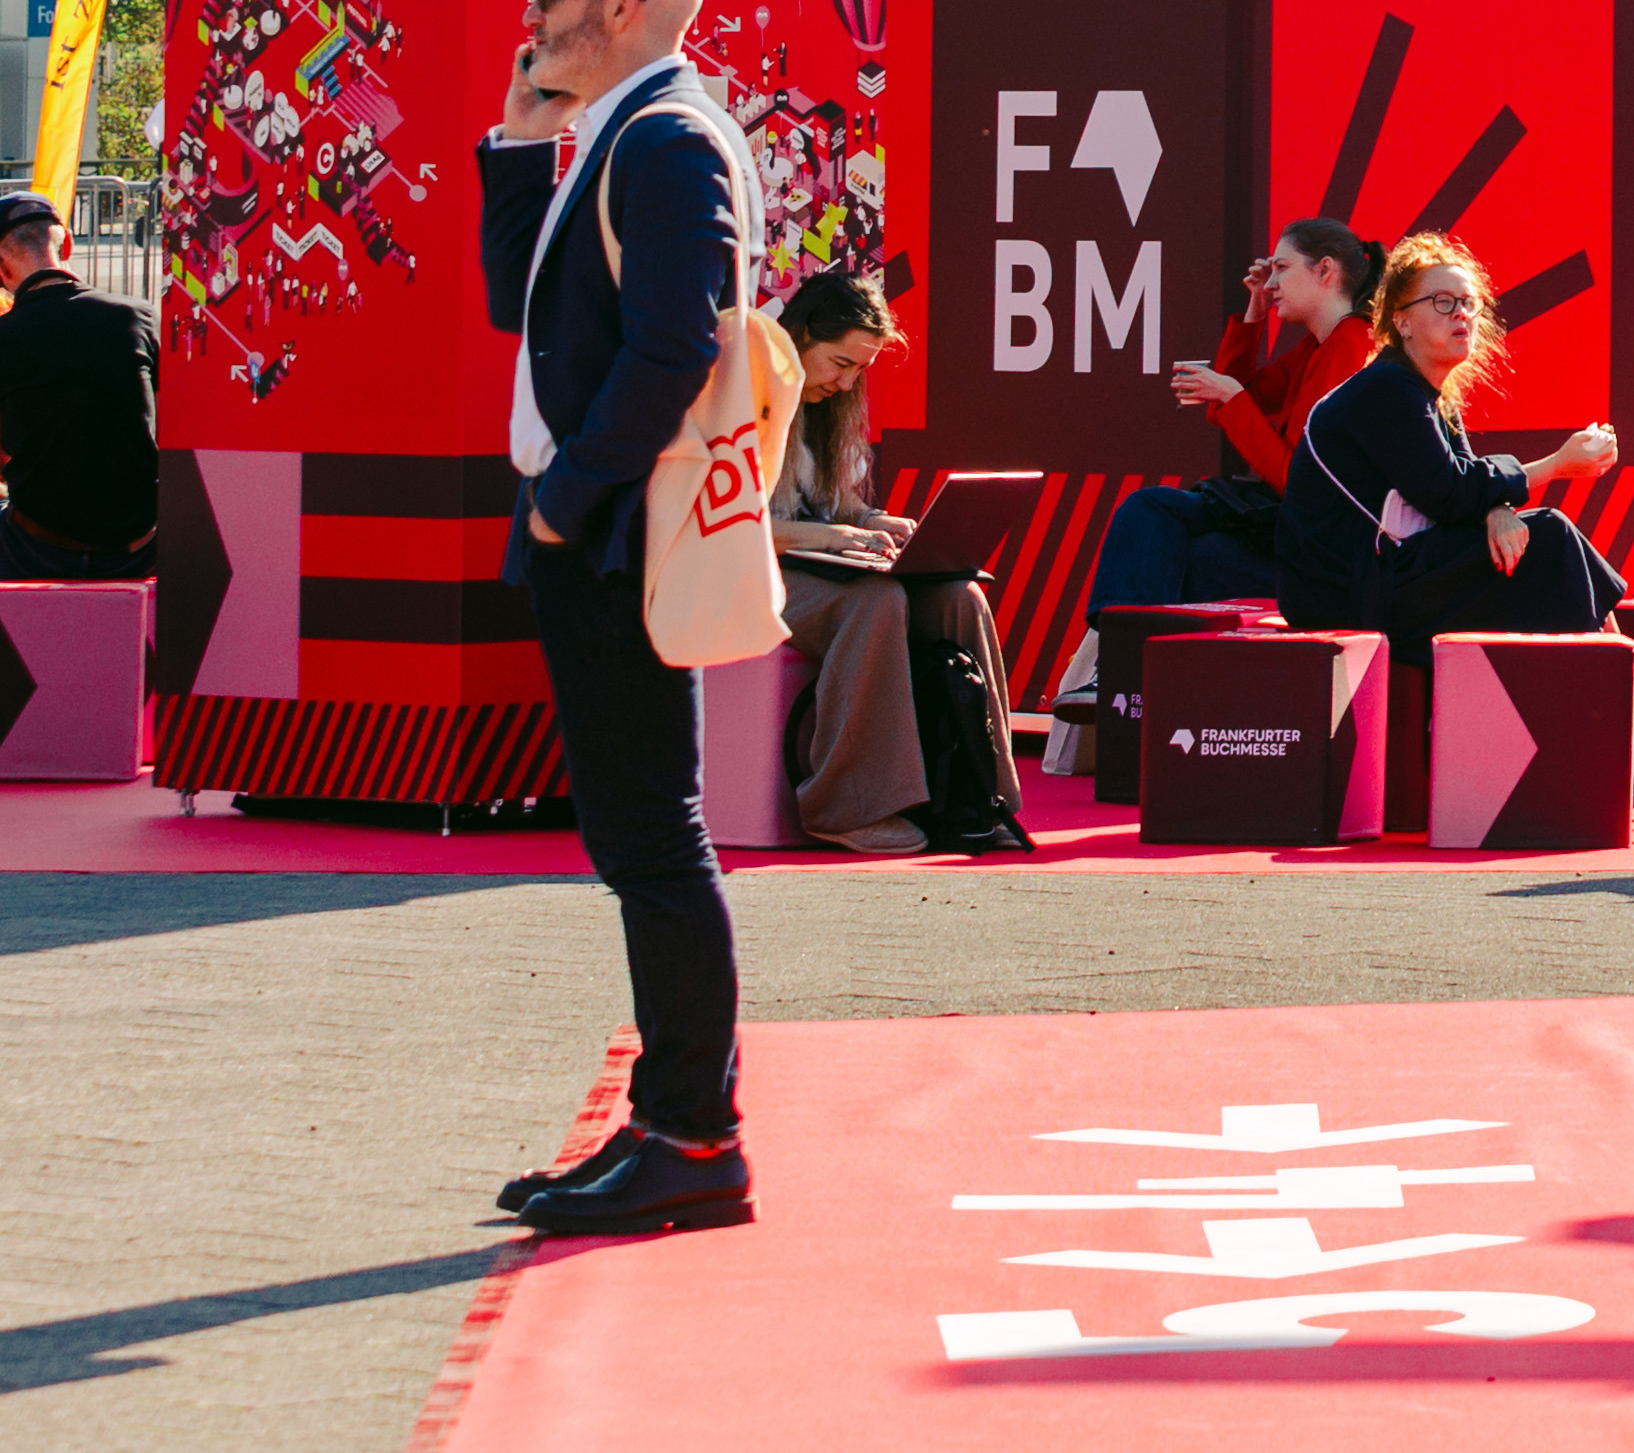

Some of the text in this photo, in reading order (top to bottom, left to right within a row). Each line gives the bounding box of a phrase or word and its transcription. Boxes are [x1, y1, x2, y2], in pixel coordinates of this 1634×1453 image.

[994, 239, 1162, 375] BM
[1201, 729, 1301, 743] FRANKFURTER
[1201, 743, 1287, 756] BUCHMESSE
